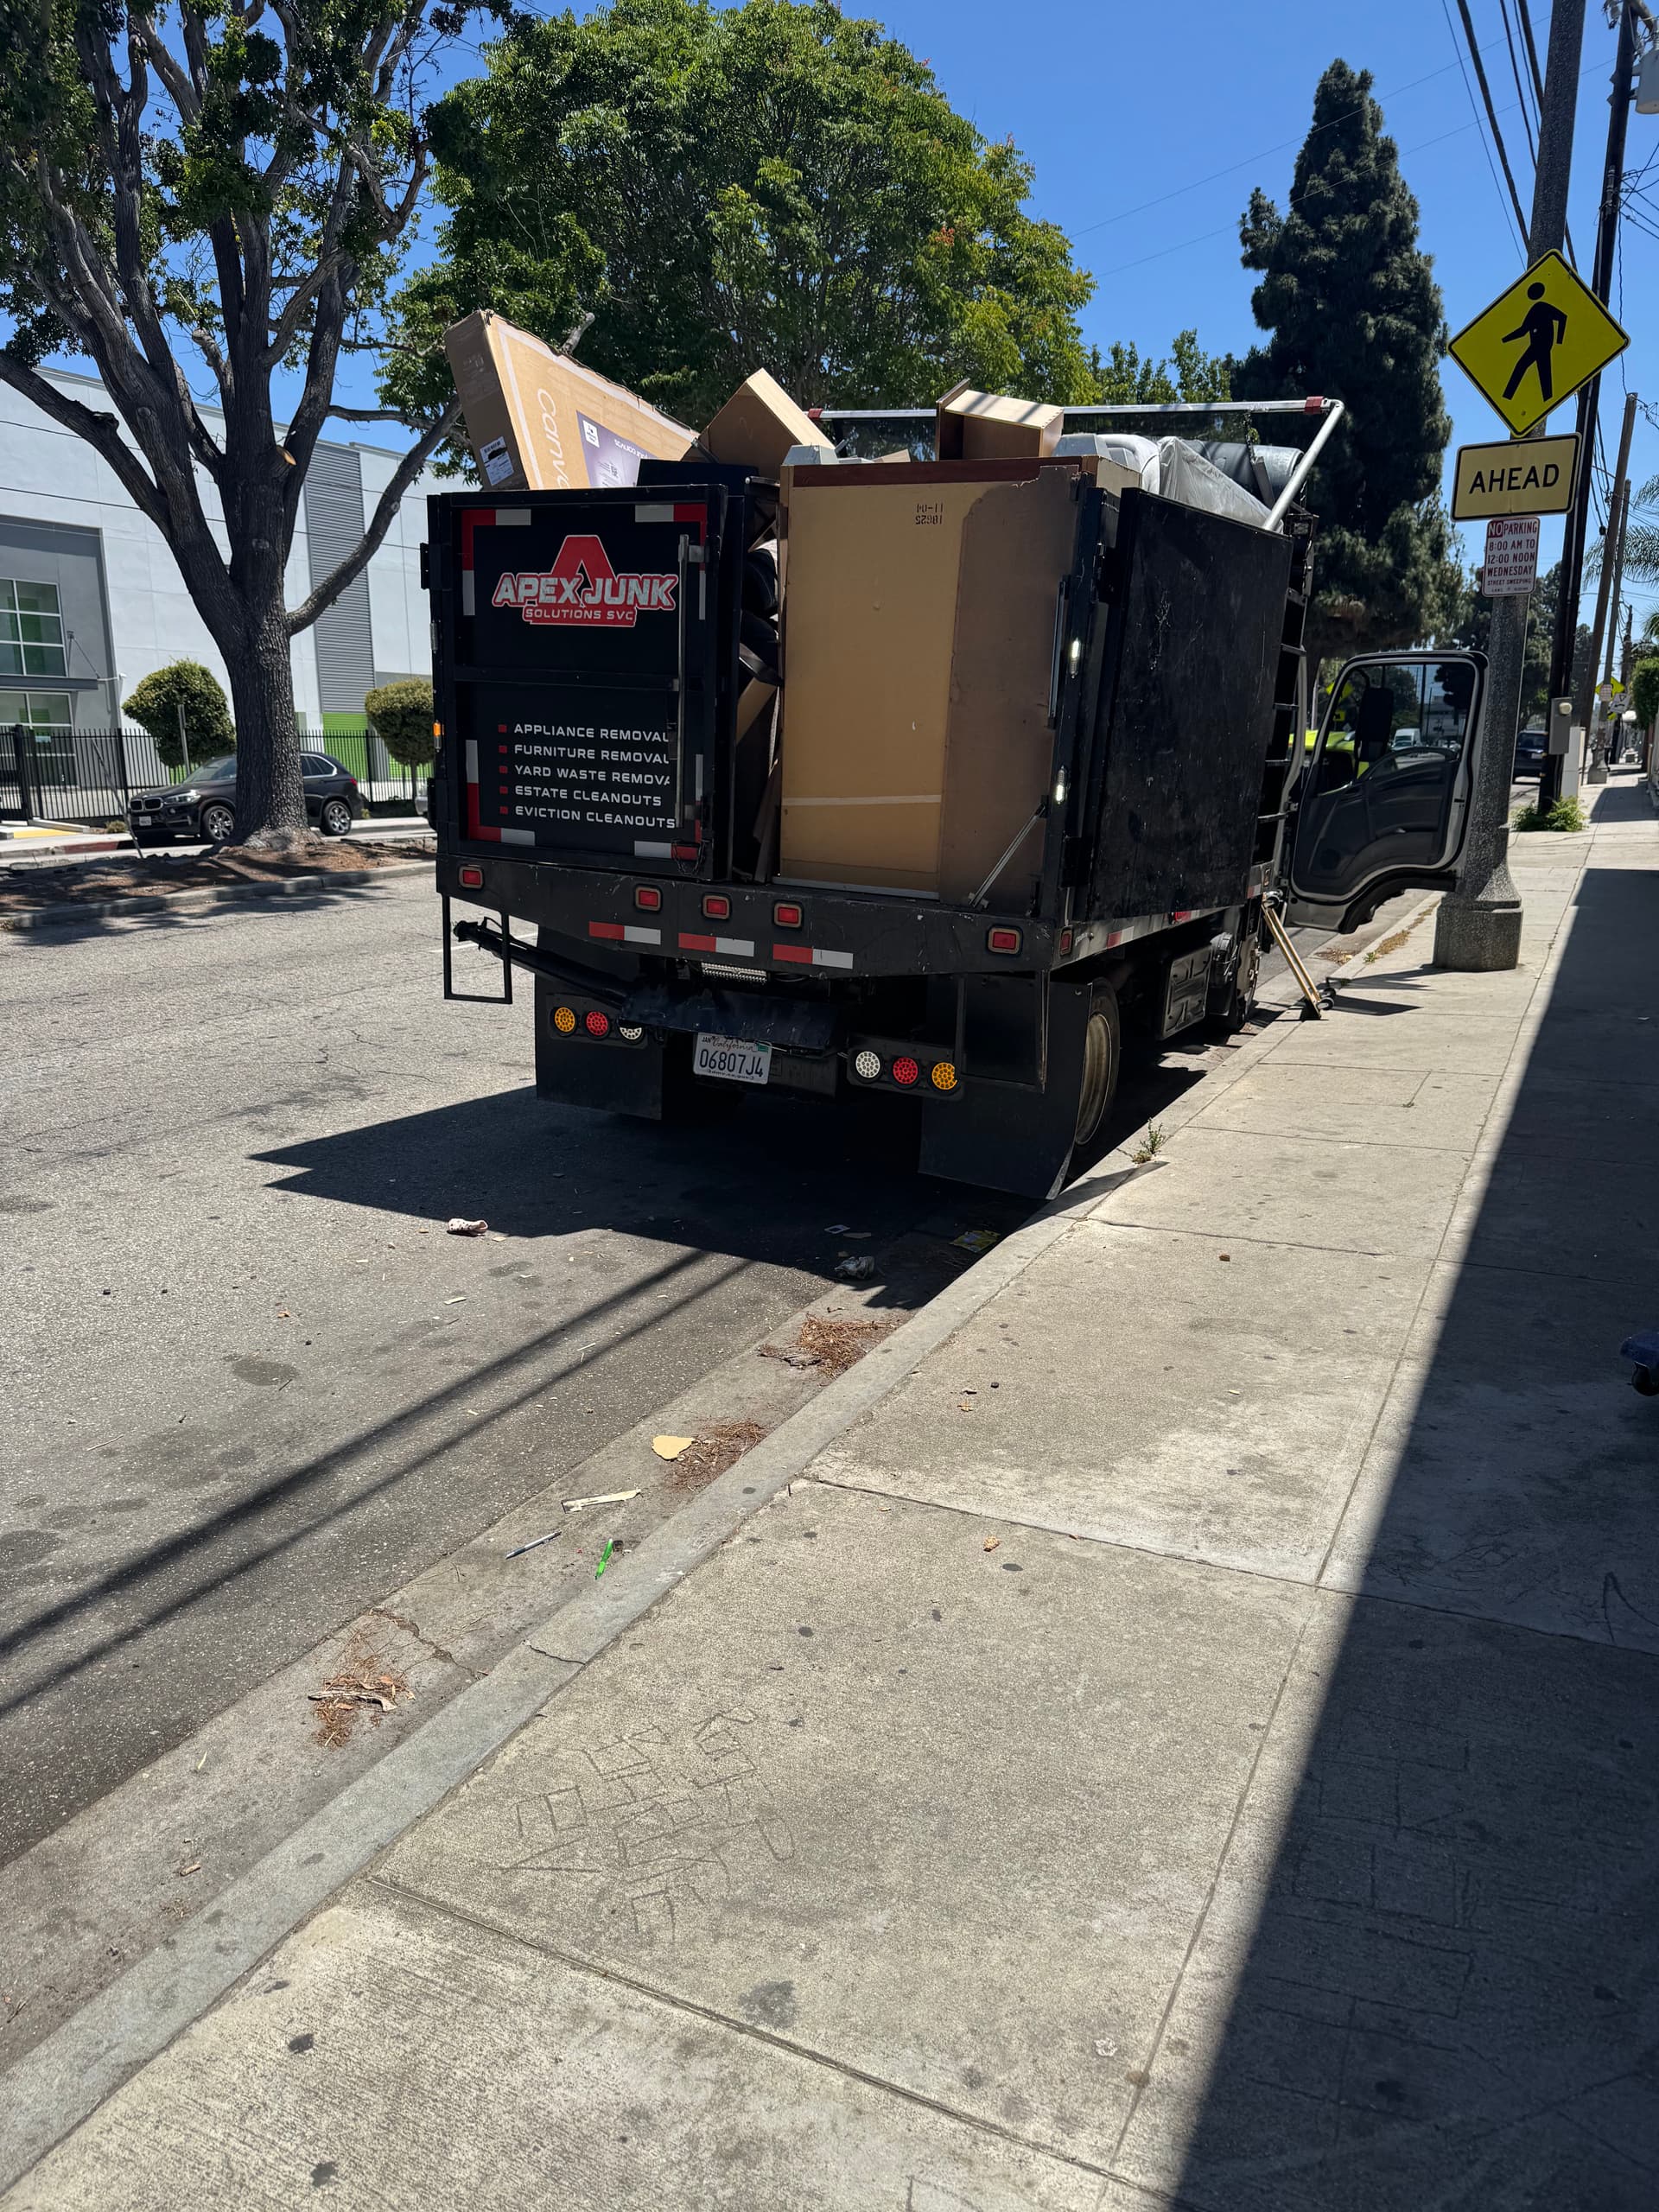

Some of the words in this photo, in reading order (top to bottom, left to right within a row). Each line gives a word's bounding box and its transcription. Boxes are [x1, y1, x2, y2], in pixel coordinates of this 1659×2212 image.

[1469, 463, 1560, 494] AHEAD
[1488, 522, 1503, 536] NO
[1503, 521, 1538, 536] PARKING
[1489, 540, 1508, 551] 8:00
[1510, 539, 1522, 550] AM
[1526, 538, 1535, 549] TO
[1487, 553, 1510, 564] 12:00
[1512, 551, 1535, 563] NOON
[1487, 565, 1534, 577] WEDNESDAY
[494, 576, 582, 604] APEX
[583, 577, 676, 607] JUNK
[524, 608, 601, 620] SOLUTIONS
[607, 610, 633, 620] SVC
[514, 724, 594, 738] APPLIANCE
[600, 728, 669, 742] REMOVAL
[514, 745, 595, 760] FURNITURE
[601, 750, 670, 764] REMOVAL
[515, 765, 551, 777] YARD
[556, 768, 607, 781] WASTE
[515, 785, 568, 799] ESTATE
[573, 791, 662, 806] CLEANOUTS
[515, 805, 581, 821] EVICTION
[586, 812, 676, 829] CLEANOUTS
[711, 1037, 756, 1052] California
[699, 1048, 764, 1077] 06807J4
